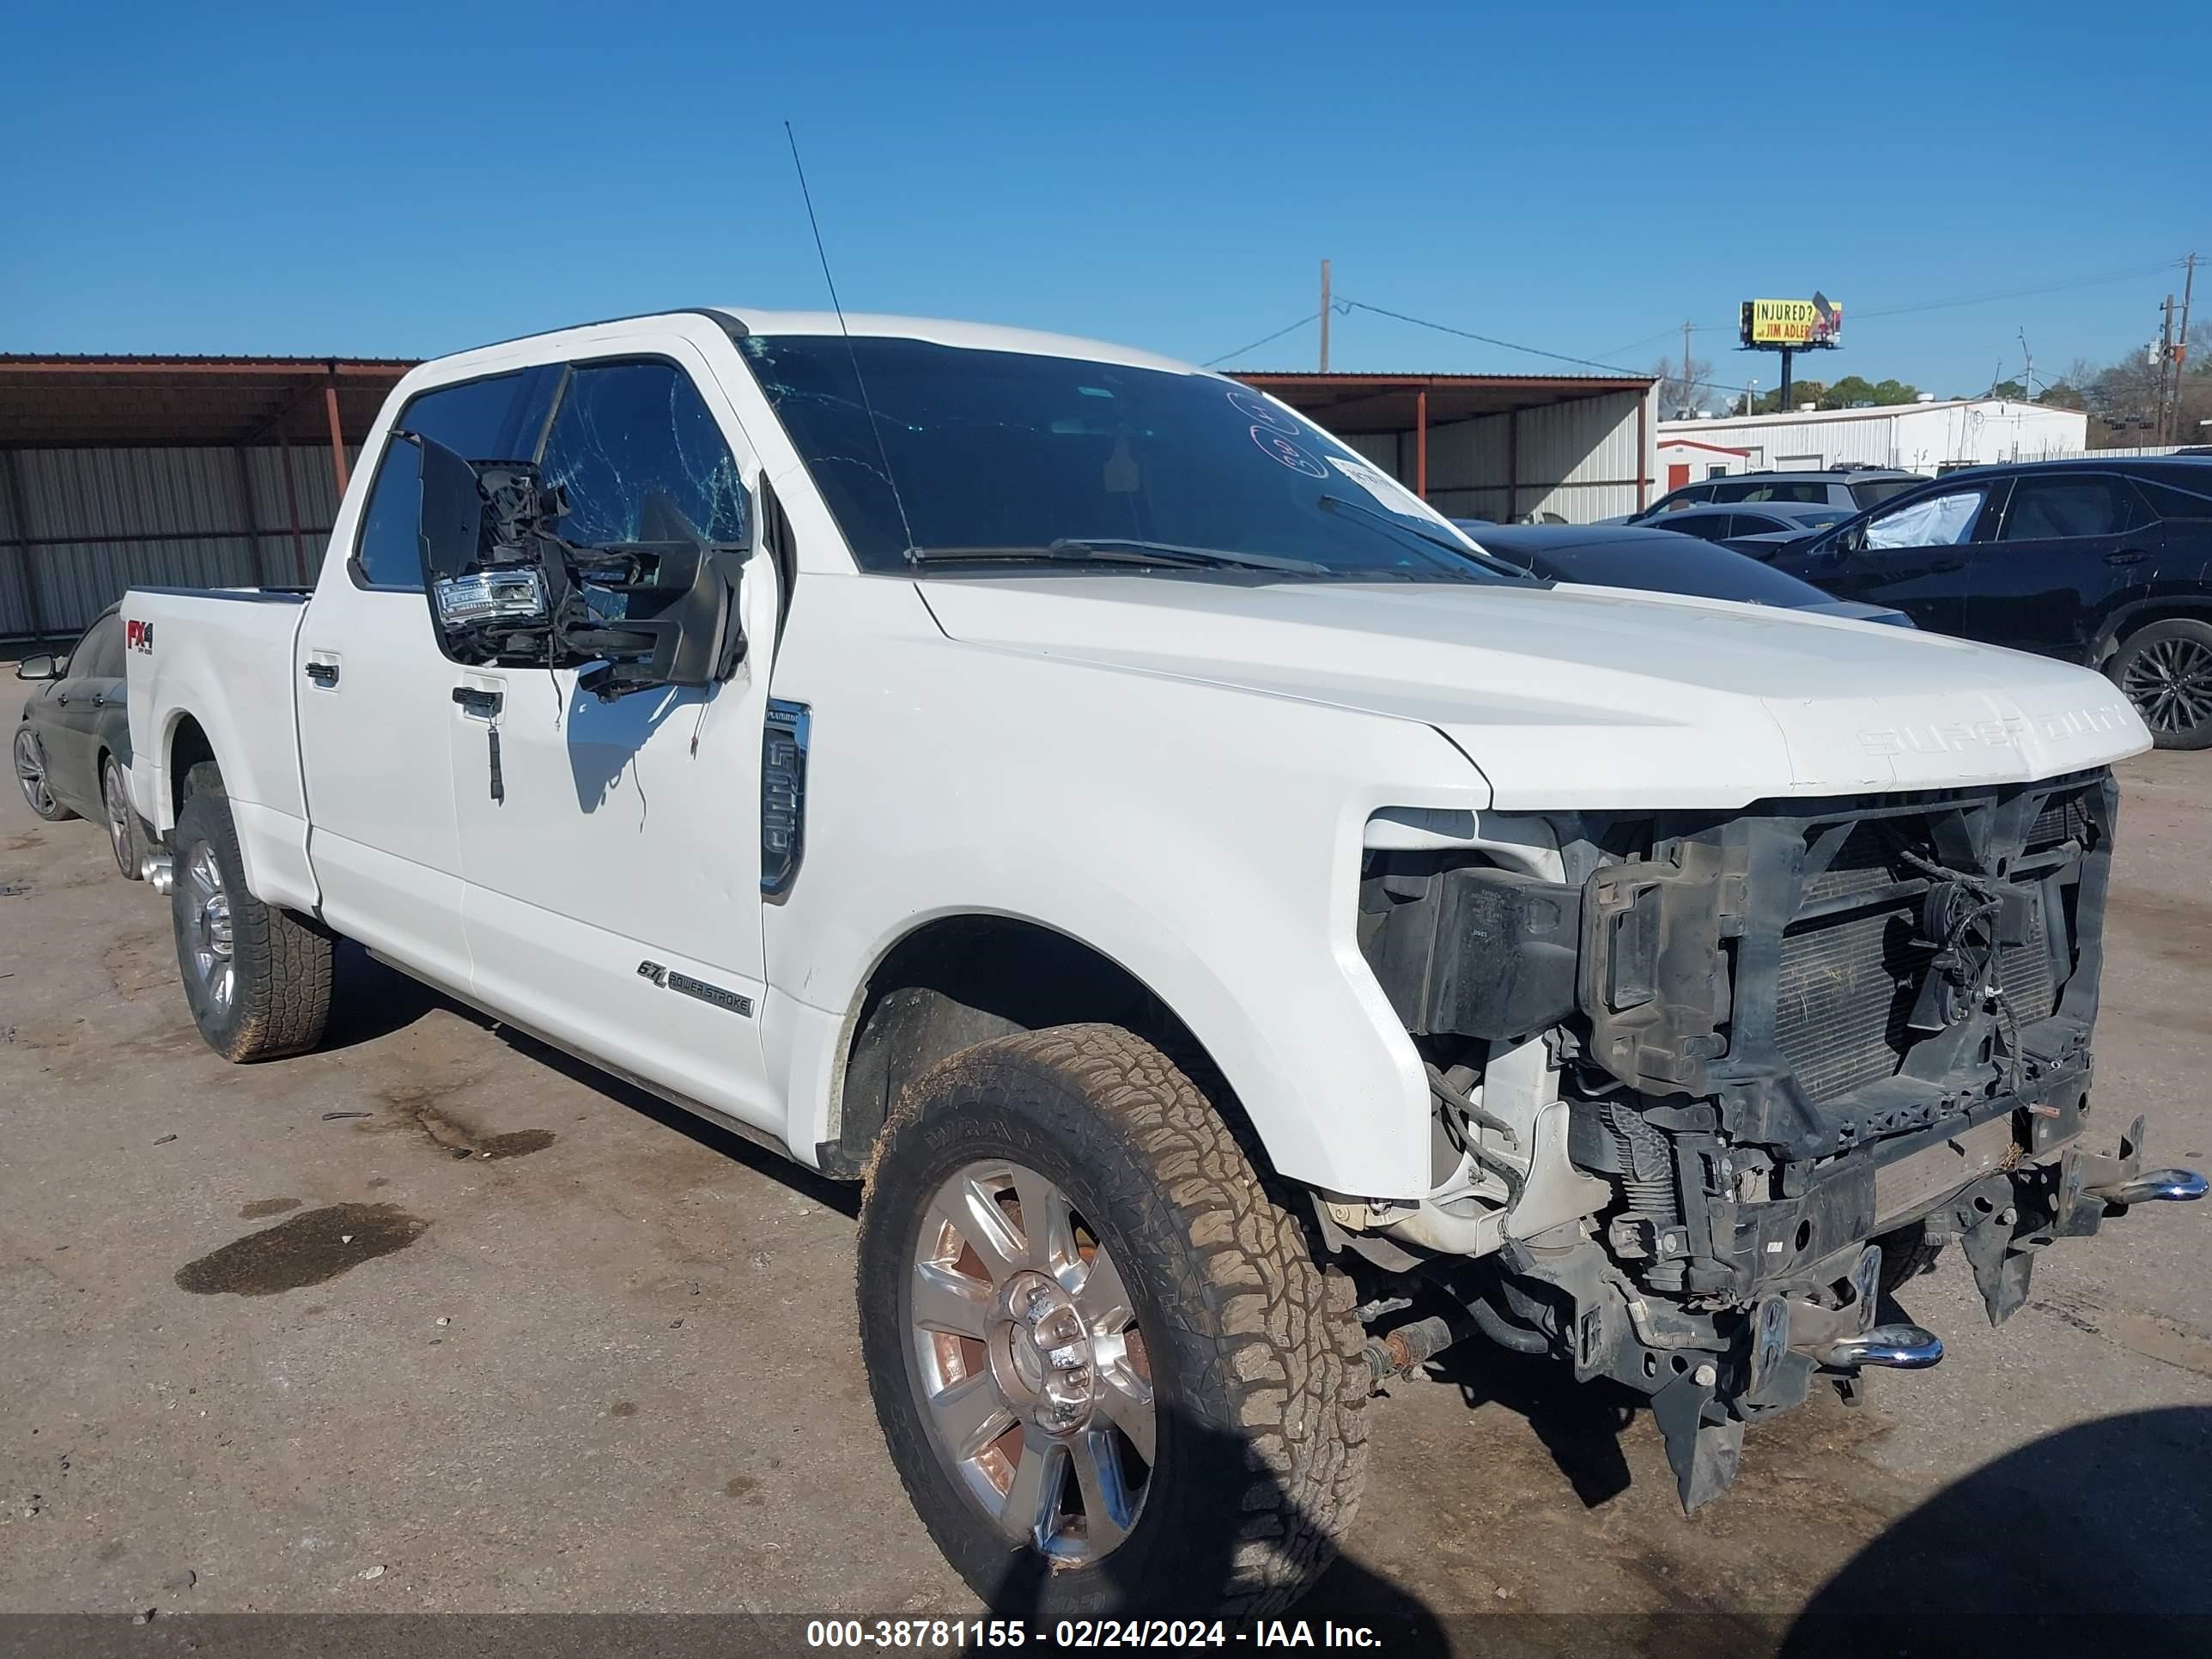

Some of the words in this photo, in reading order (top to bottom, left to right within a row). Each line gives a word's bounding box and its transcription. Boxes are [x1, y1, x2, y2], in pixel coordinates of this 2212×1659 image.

[1757, 303, 1813, 321] INJURED?
[1765, 324, 1781, 338] JIM
[1784, 324, 1810, 339] ADLER
[127, 619, 153, 650] FX4
[1855, 714, 2026, 757] SUPER
[2036, 702, 2129, 743] DUTY
[670, 974, 704, 994] POWER
[706, 988, 749, 1011] STROKE
